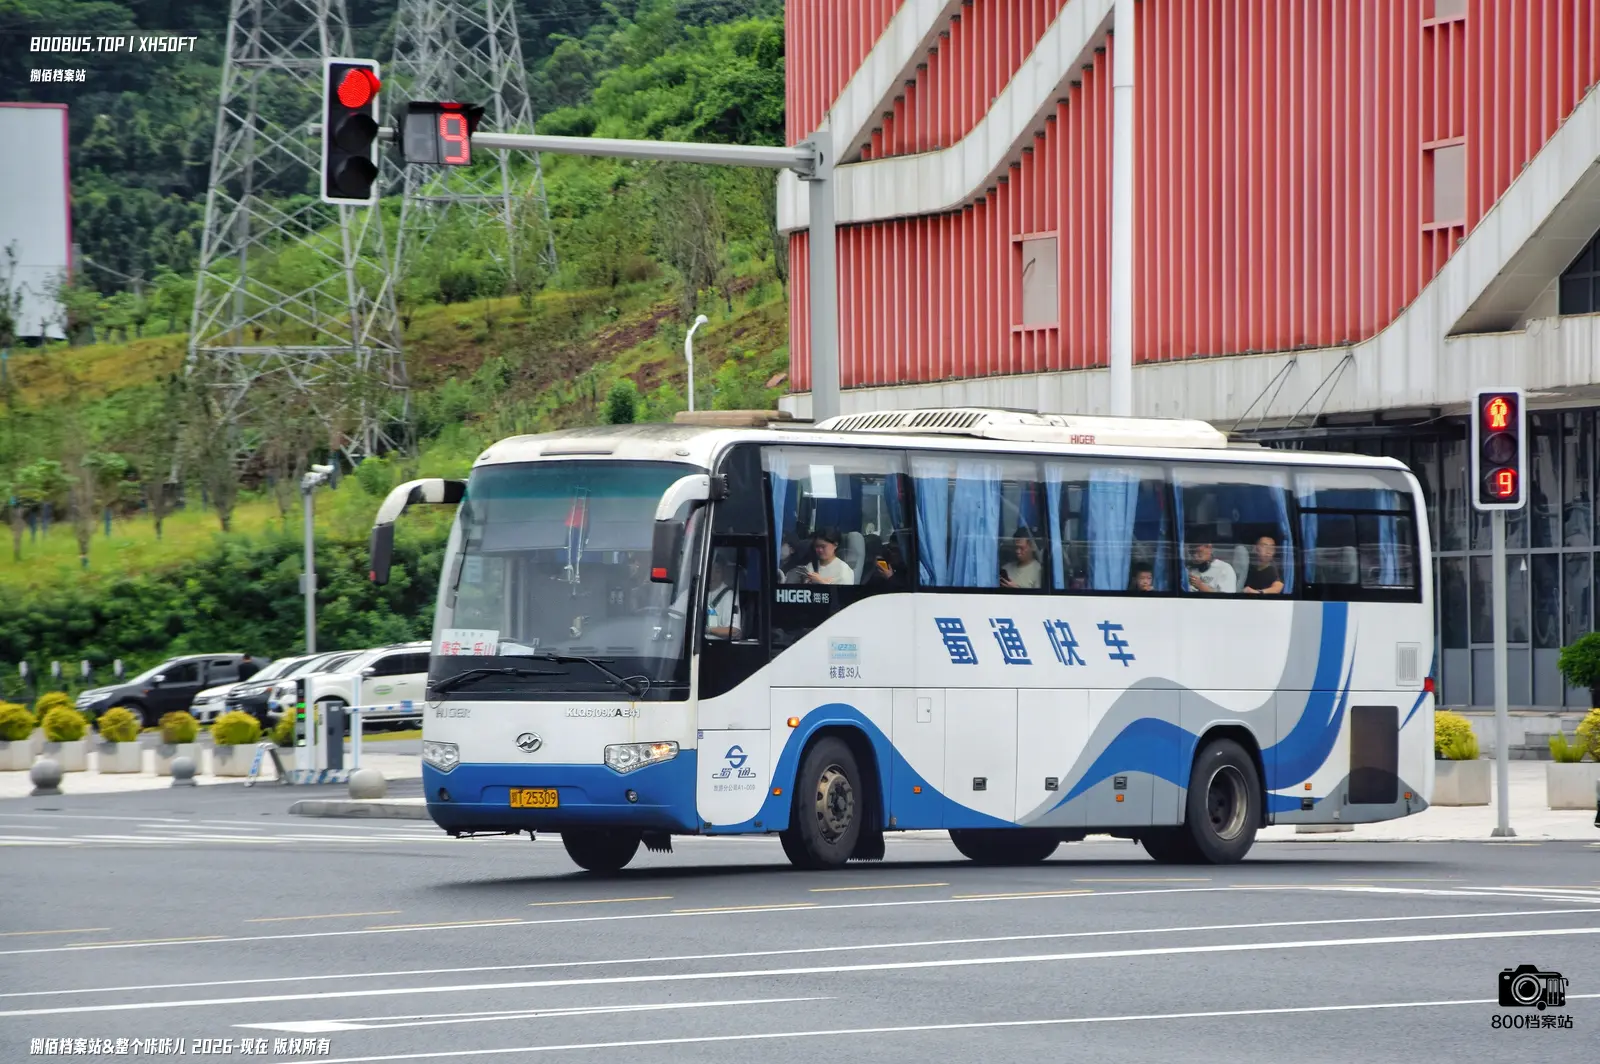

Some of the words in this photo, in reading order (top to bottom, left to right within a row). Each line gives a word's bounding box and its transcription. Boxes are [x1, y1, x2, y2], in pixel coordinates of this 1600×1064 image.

[439, 112, 470, 163] 9
[1070, 434, 1096, 444] HIGER
[1499, 472, 1512, 494] 9
[776, 589, 812, 603] HIGER
[934, 617, 1136, 667] 蜀通快车
[829, 665, 862, 679] 核载39人
[436, 708, 471, 719] HIGER
